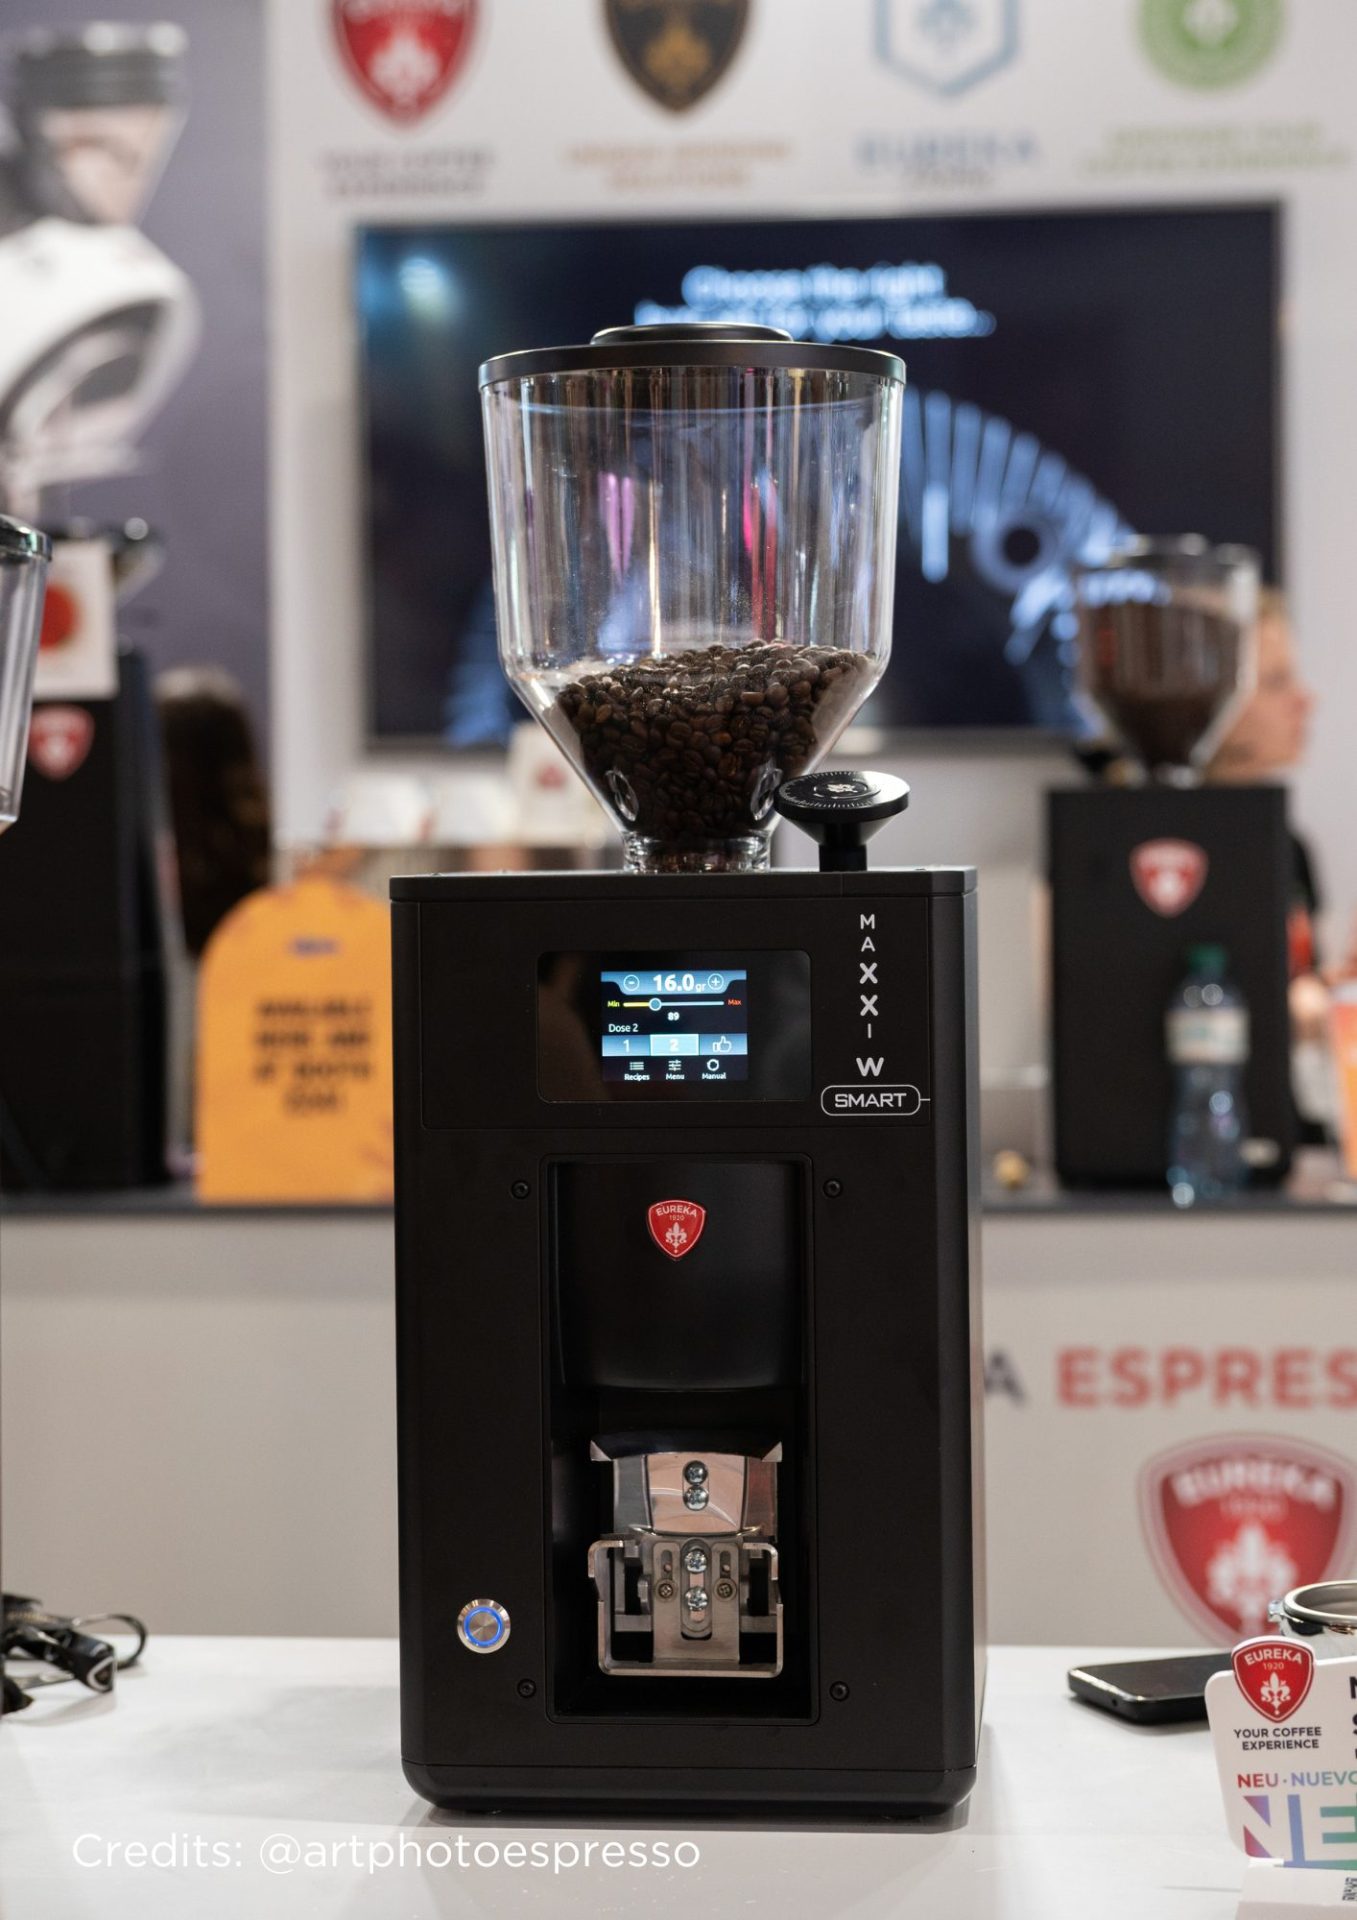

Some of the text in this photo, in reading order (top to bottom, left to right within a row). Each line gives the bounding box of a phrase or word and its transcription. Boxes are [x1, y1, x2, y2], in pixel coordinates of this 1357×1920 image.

[653, 973, 694, 991] 16.0
[855, 913, 885, 1078] MAXXI W
[607, 1000, 620, 1008] Min
[667, 1011, 680, 1021] 89
[608, 1023, 638, 1033] Dose 2
[623, 1040, 630, 1052] 1
[669, 1040, 679, 1051] 2
[624, 1073, 650, 1082] Recipes
[666, 1073, 684, 1081] Menu
[702, 1072, 726, 1080] Manual
[834, 1092, 908, 1108] SMART
[656, 1205, 697, 1218] EUREKA
[1244, 1648, 1302, 1665] EUREKA
[1263, 1661, 1284, 1670] 1920
[1234, 1726, 1322, 1739] YOUR COFFEE
[1242, 1739, 1319, 1751] EXPERIENCE
[1237, 1773, 1279, 1788] NEU
